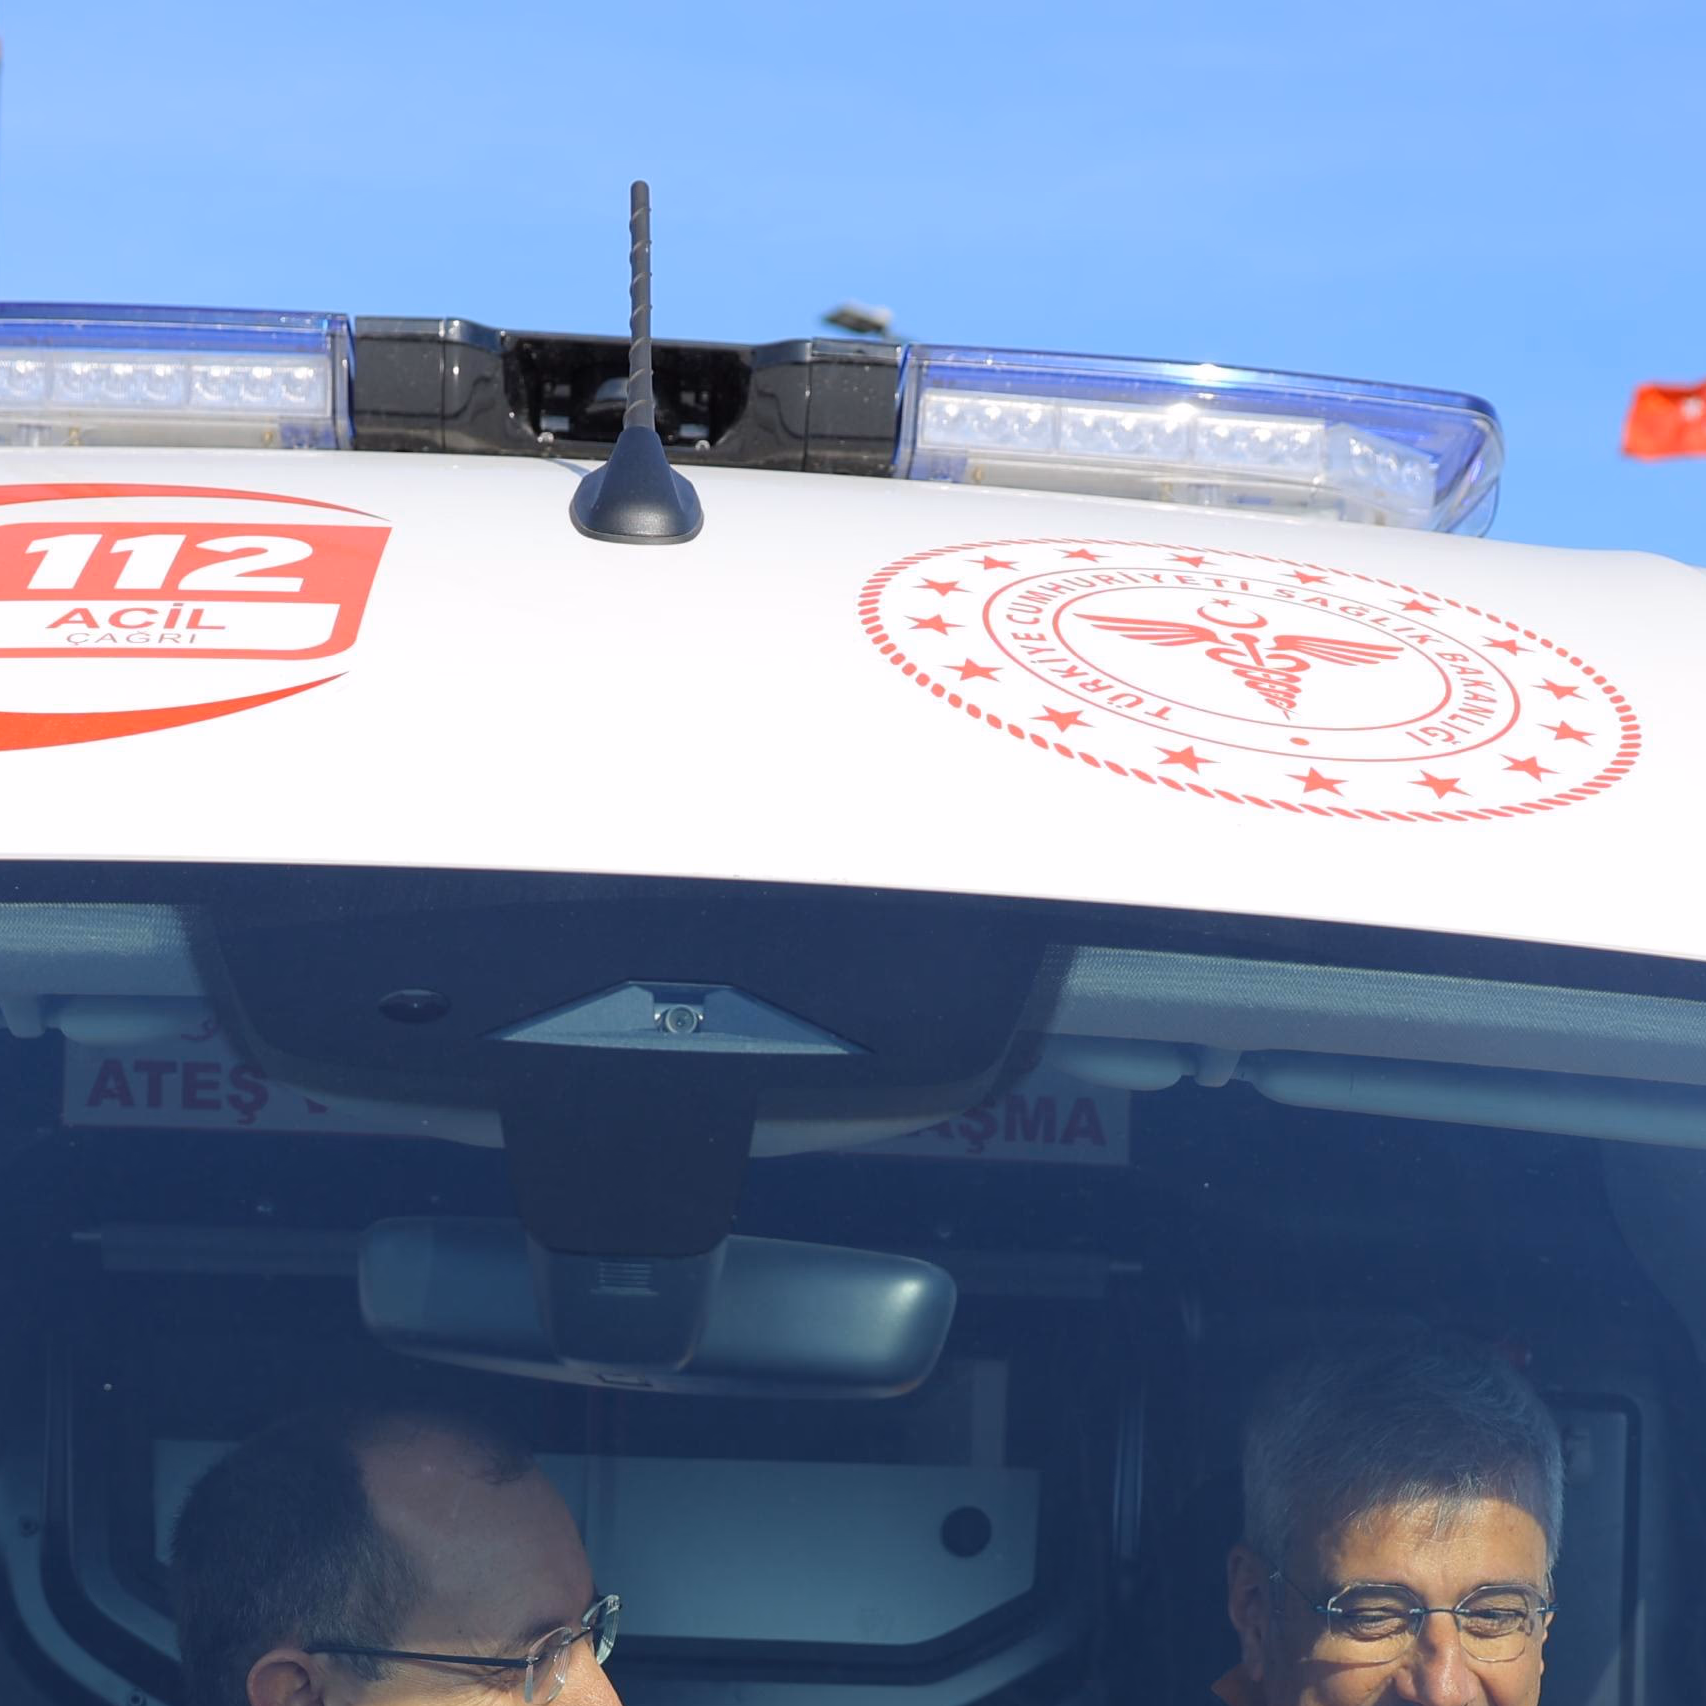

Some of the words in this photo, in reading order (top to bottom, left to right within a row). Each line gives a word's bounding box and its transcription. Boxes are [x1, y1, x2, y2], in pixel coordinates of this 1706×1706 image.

[24, 534, 314, 592] 112
[45, 602, 226, 630] ACİL
[1006, 571, 1250, 626] CUMHURİYETİ
[1276, 587, 1443, 647] SAĞLIK
[65, 630, 197, 645] ÇAĞRI
[1010, 631, 1175, 722] TÜRKİYE
[1405, 652, 1499, 748] BAKANLIĞI
[87, 1059, 269, 1125] ATEŞ
